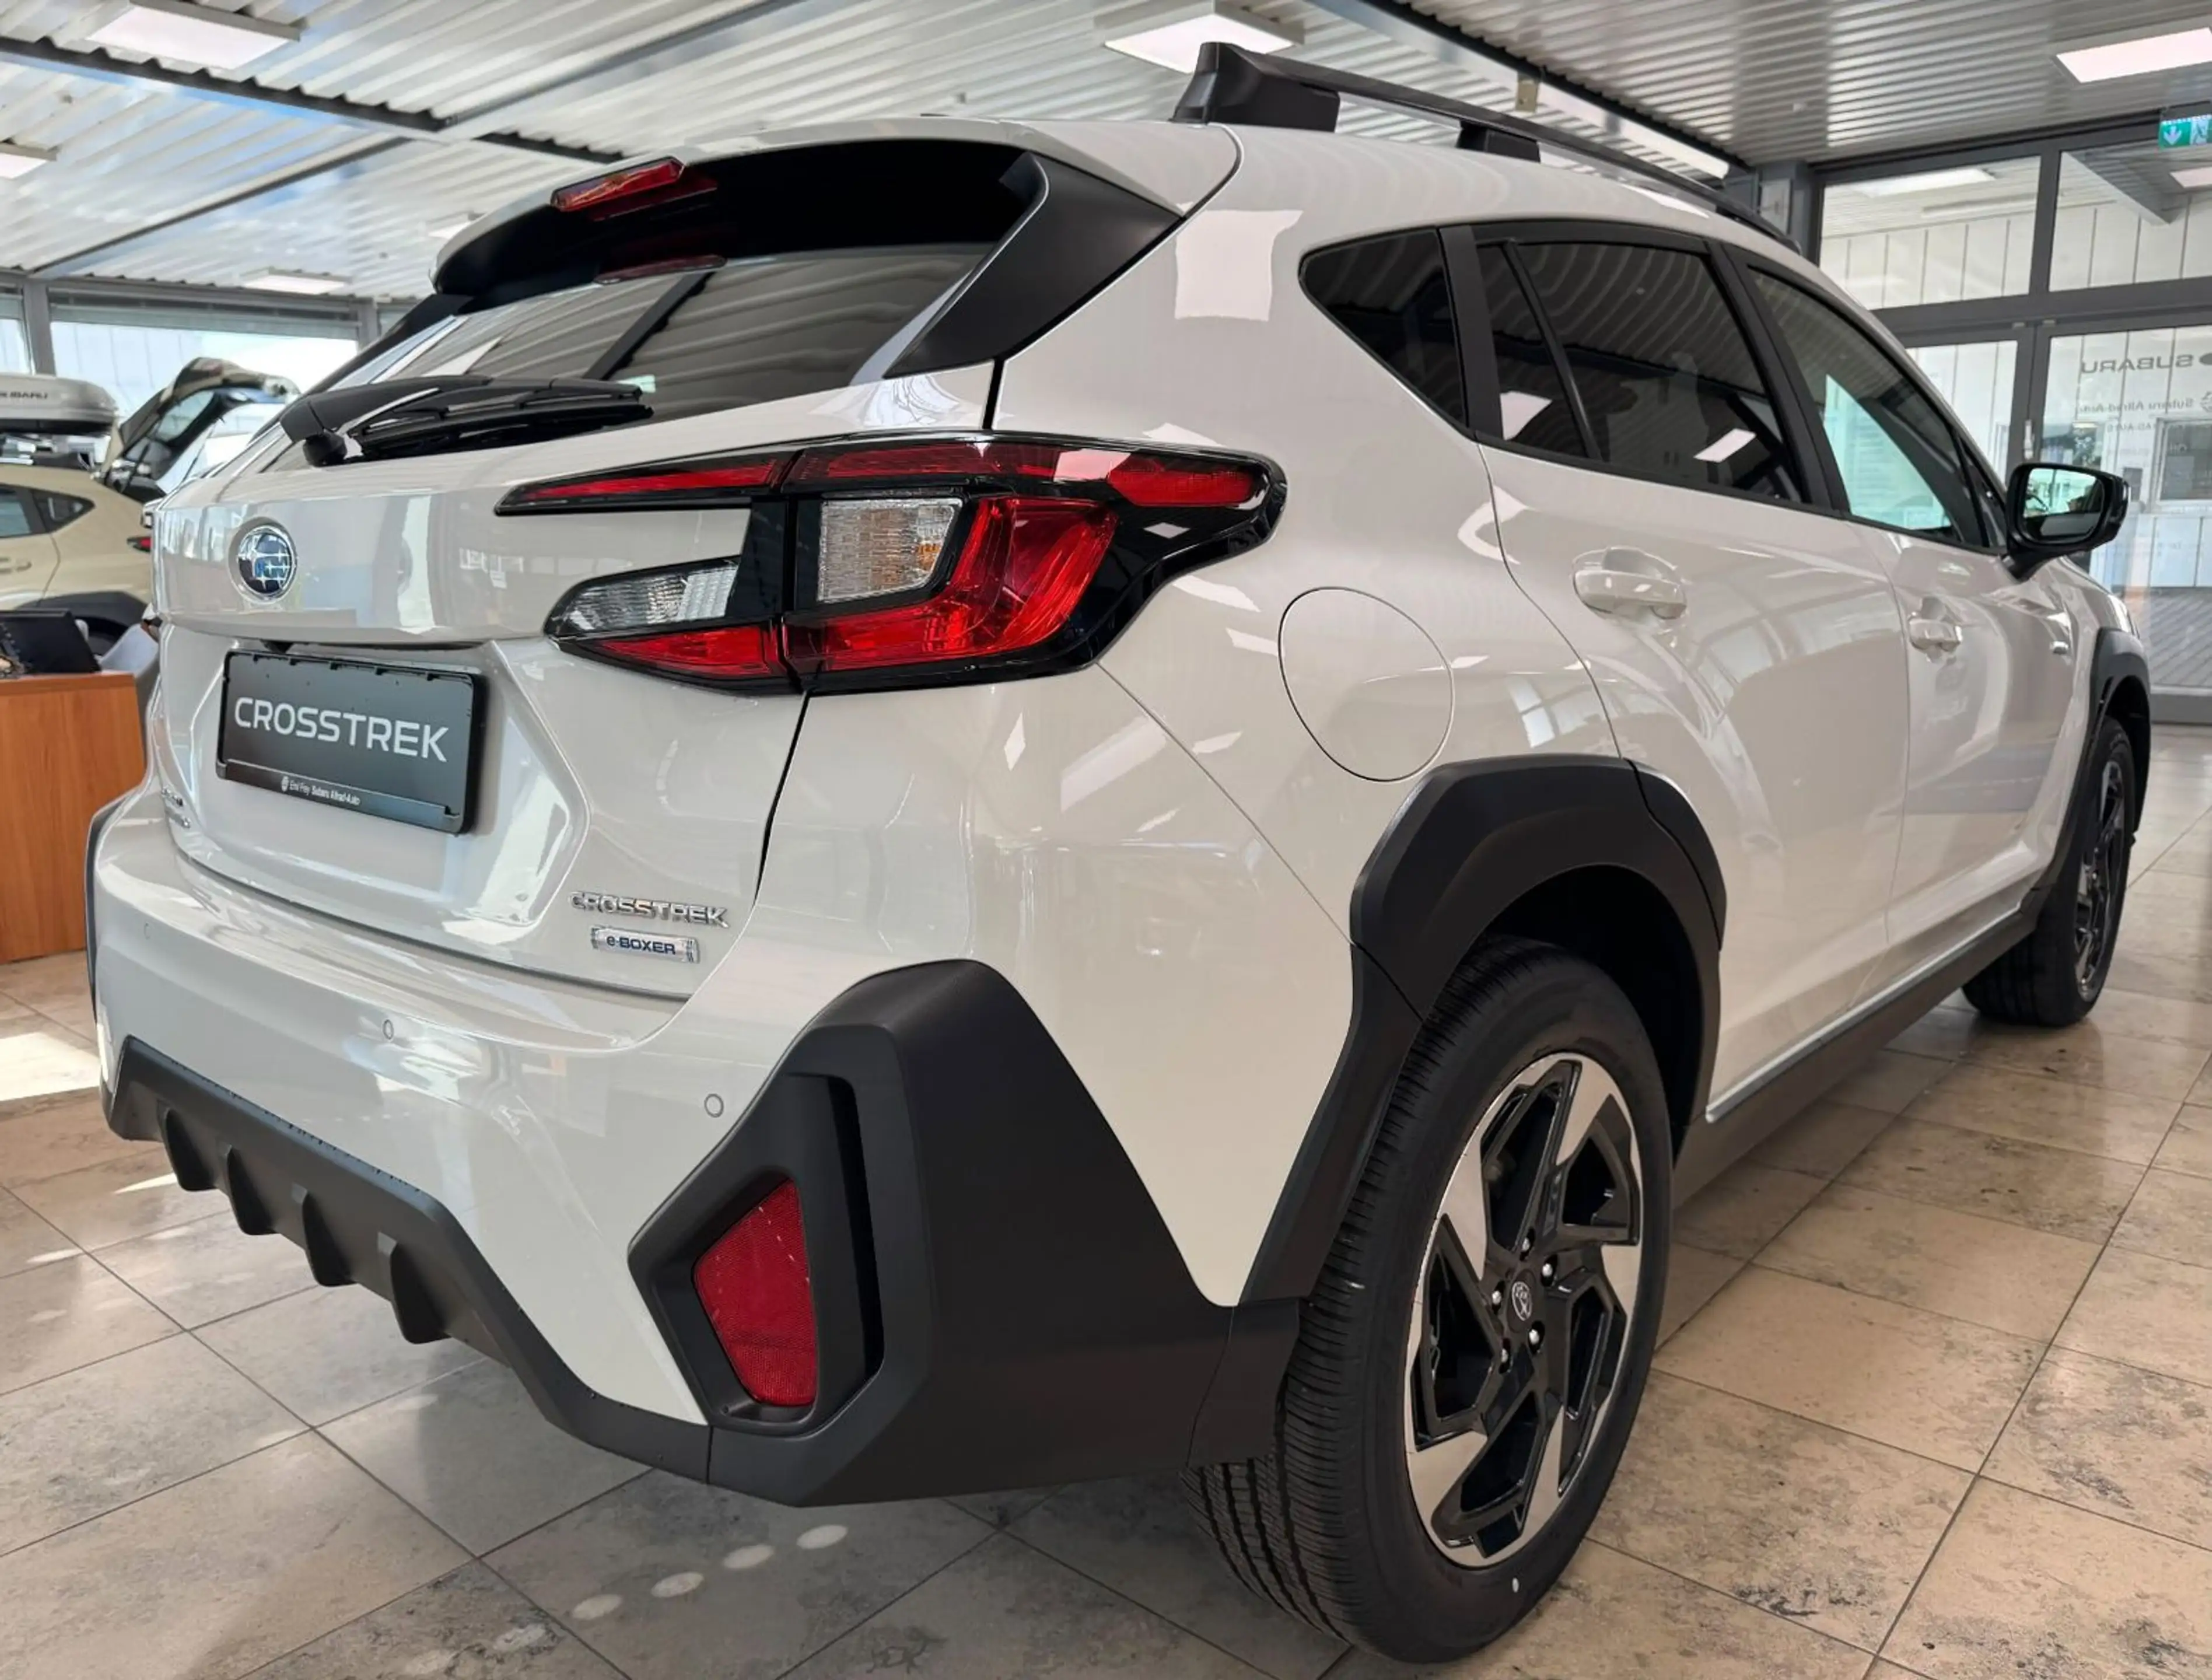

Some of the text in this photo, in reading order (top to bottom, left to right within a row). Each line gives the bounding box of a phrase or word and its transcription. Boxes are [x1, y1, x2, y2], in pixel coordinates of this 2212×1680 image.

[234, 697, 449, 763] CROSSTREK
[568, 890, 729, 928] CROSSTREK
[606, 936, 676, 956] e-BOXER
